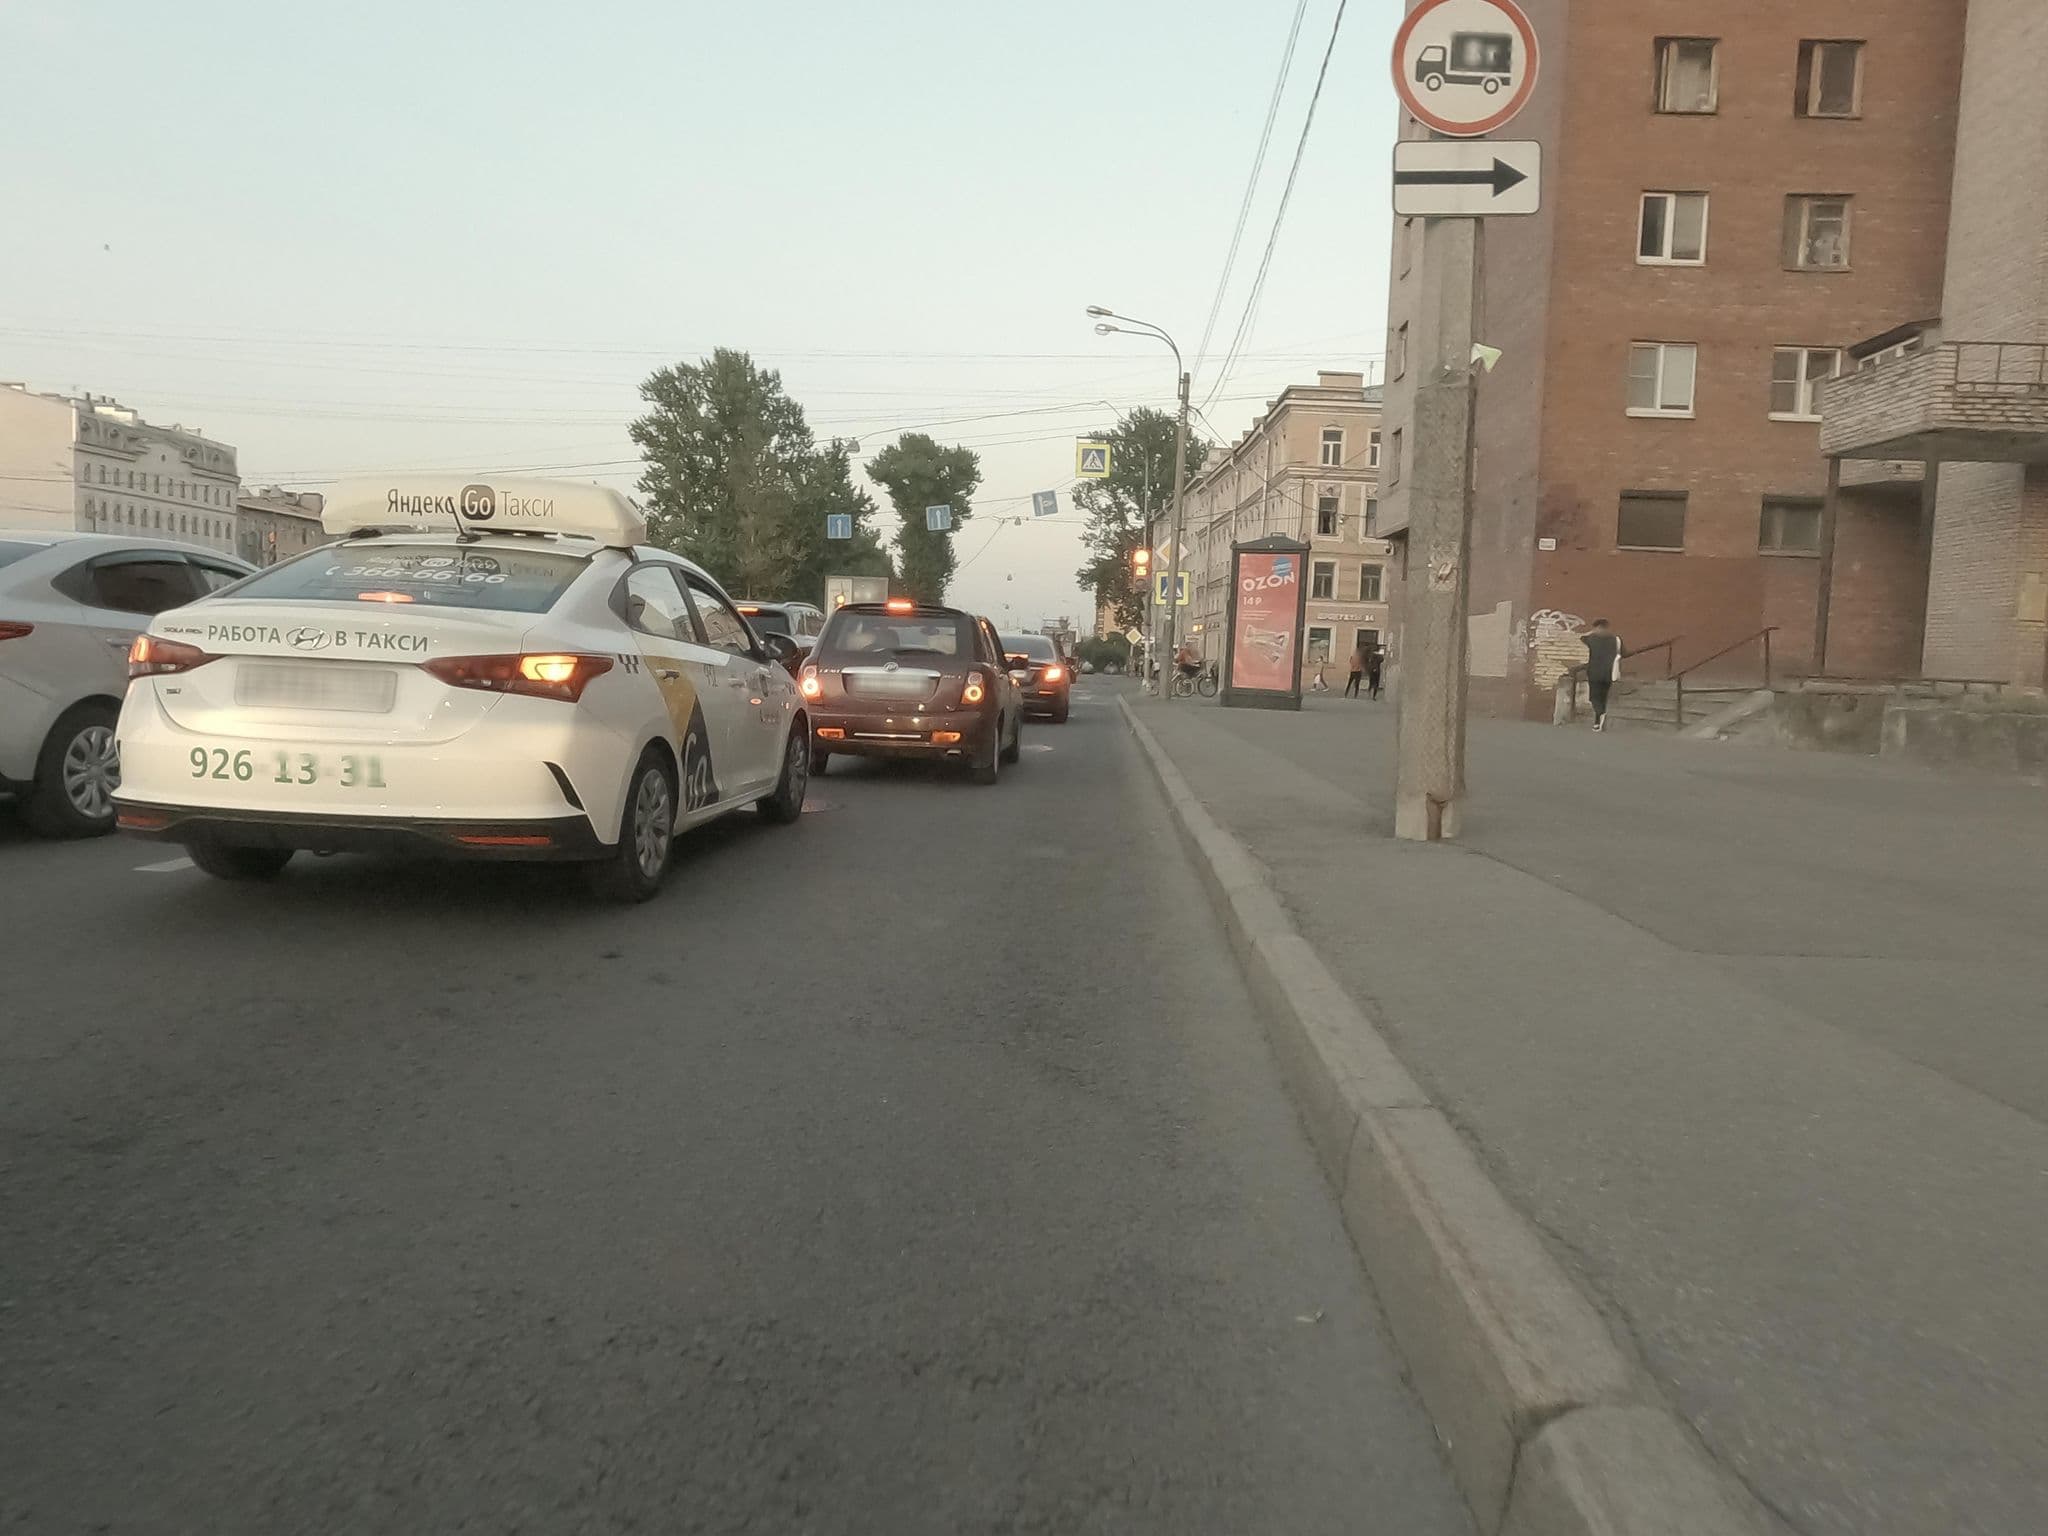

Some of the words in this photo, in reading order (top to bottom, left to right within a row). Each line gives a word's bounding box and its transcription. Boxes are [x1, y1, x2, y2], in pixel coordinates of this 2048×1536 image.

[388, 488, 455, 516] Яндекс
[464, 486, 491, 516] Go
[501, 491, 554, 517] Такси
[344, 566, 509, 584] 366-66-66
[1242, 571, 1295, 592] OZON
[208, 625, 281, 643] РАБОТА
[335, 631, 347, 646] В
[355, 631, 428, 652] ТАКСИ
